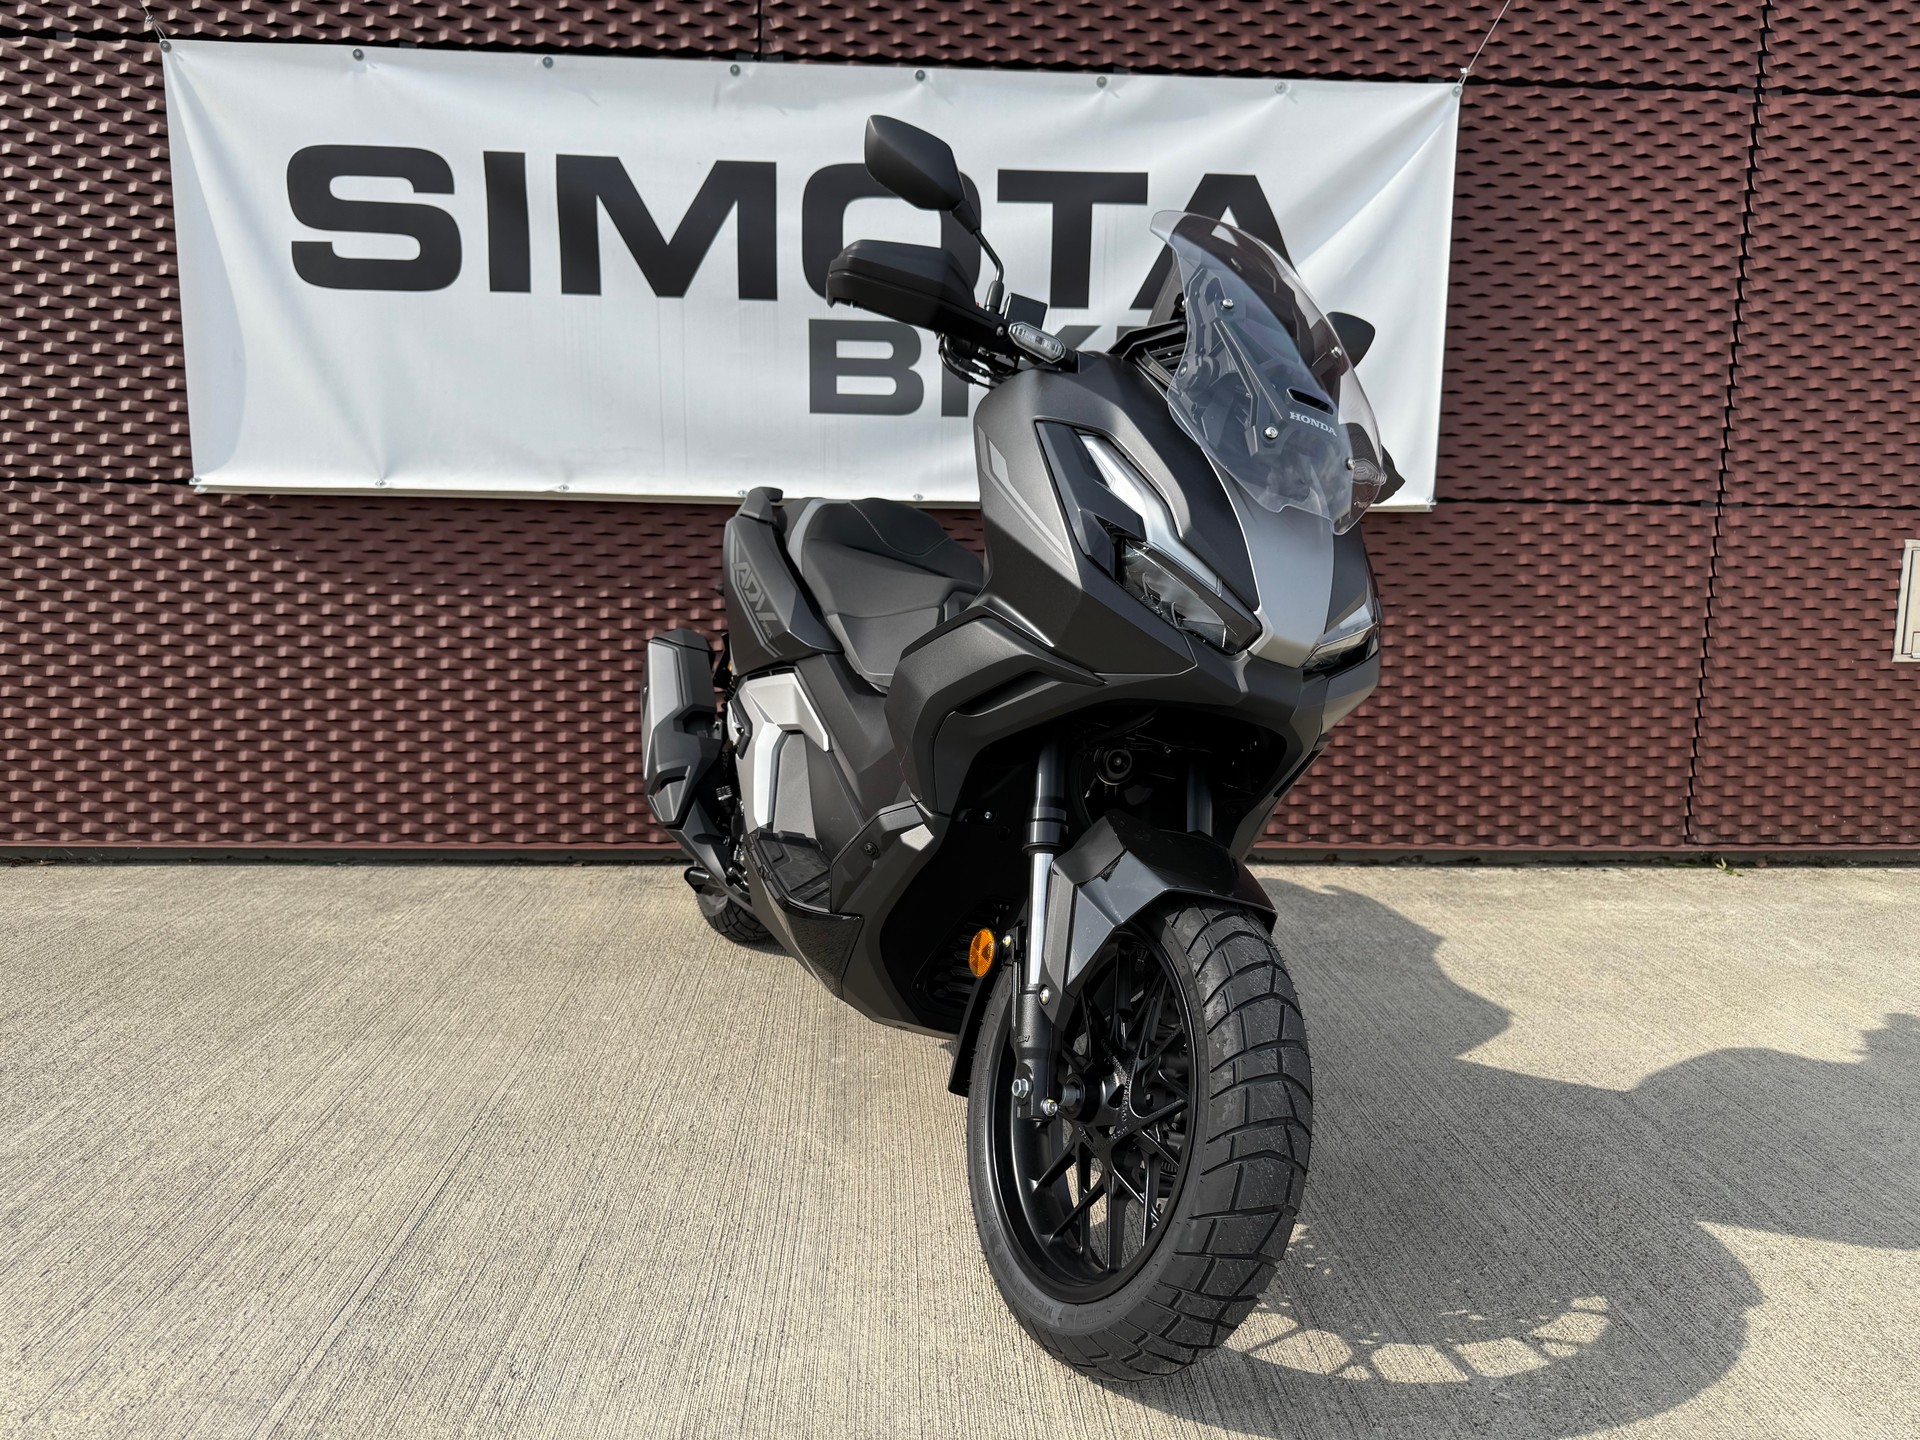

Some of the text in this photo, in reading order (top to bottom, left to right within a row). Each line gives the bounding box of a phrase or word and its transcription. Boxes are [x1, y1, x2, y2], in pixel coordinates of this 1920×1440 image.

[286, 144, 1303, 311] SIMOTA
[1289, 411, 1338, 437] HONDA
[732, 561, 779, 621] ADV
